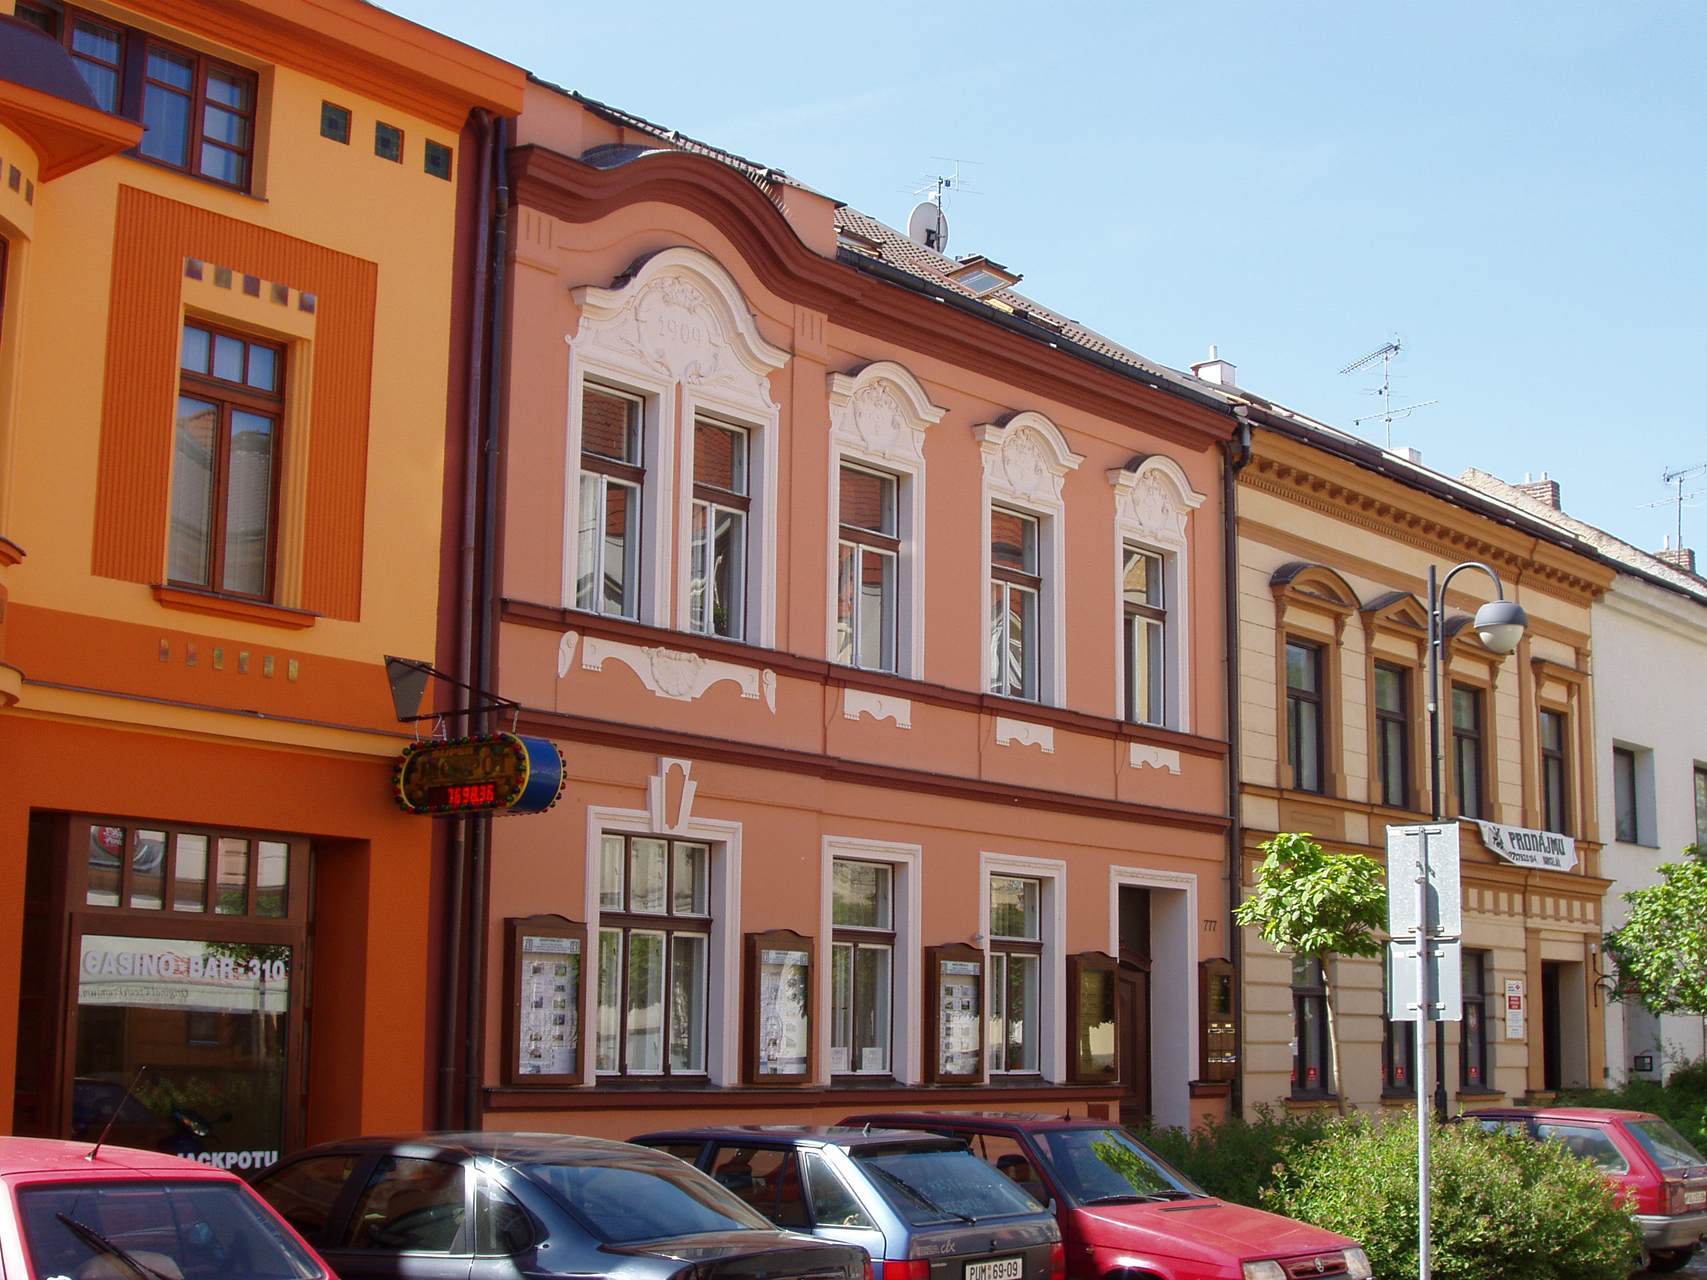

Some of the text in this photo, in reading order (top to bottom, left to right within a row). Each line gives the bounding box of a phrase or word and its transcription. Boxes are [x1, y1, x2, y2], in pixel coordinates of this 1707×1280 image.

[658, 316, 701, 348] 1909
[1204, 919, 1217, 932] 777
[84, 950, 286, 982] CASINO BAR 310
[177, 1150, 279, 1170] CKPOTU
[969, 1260, 1019, 1280] PUM 69-09
